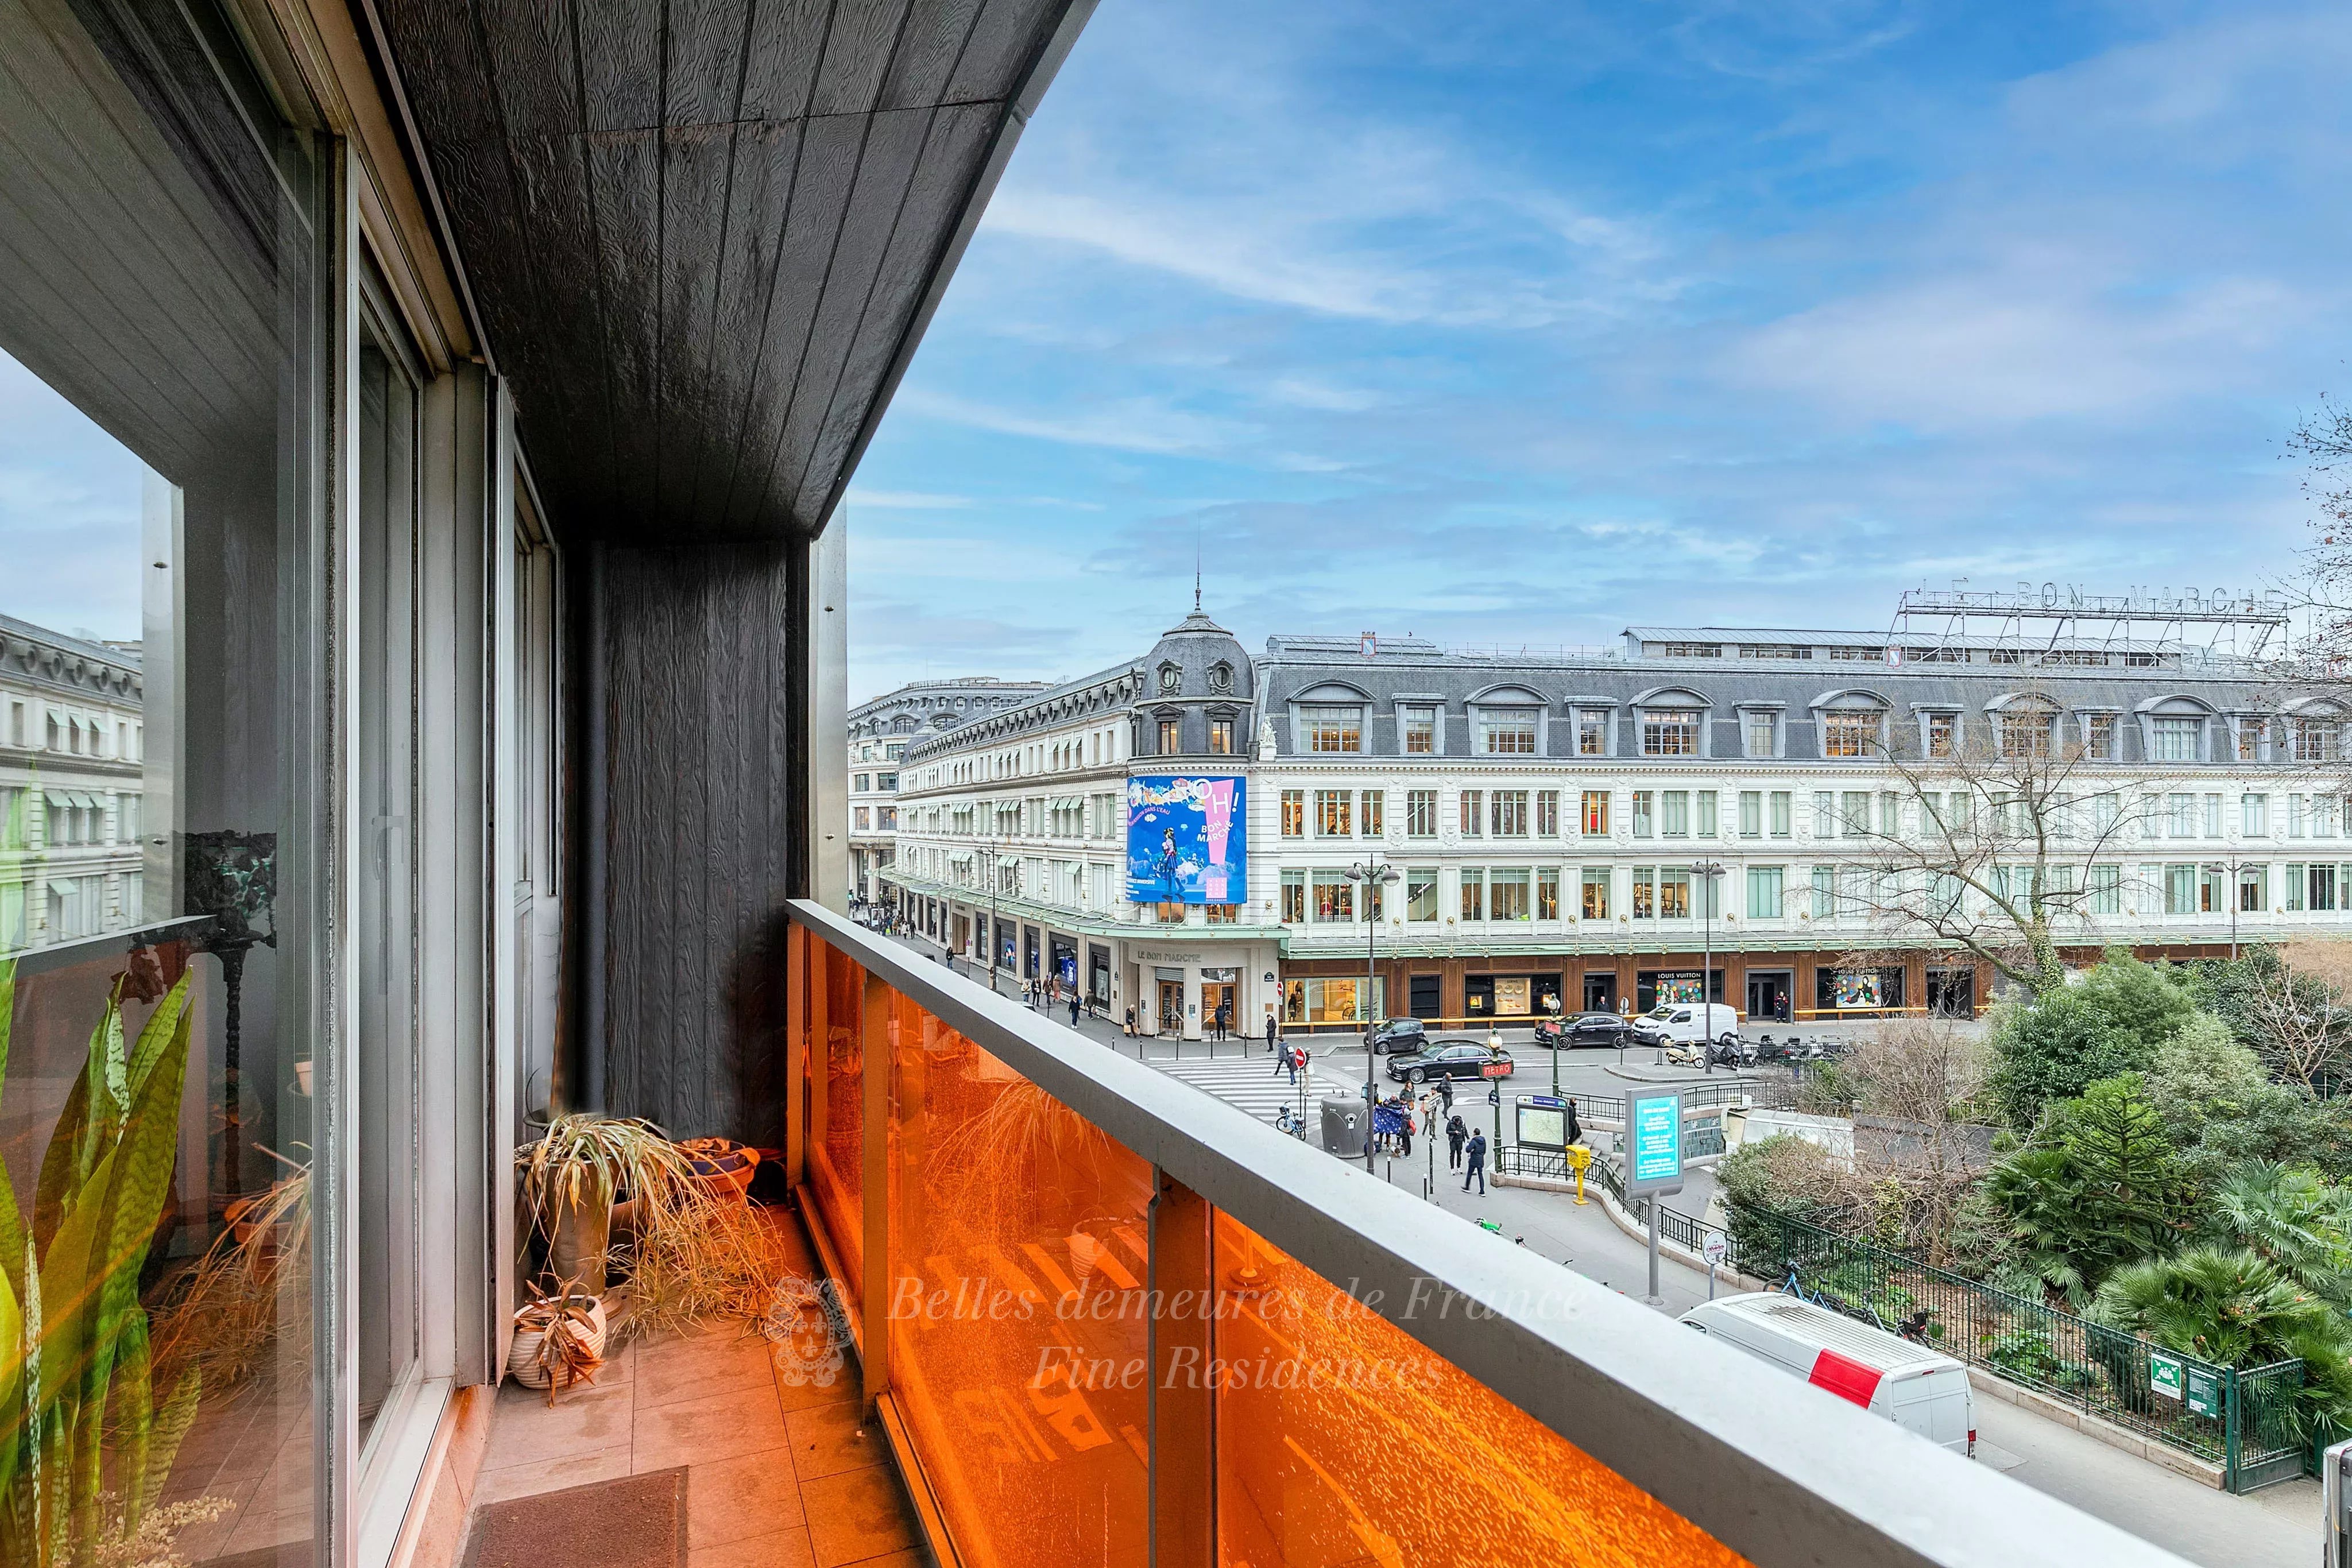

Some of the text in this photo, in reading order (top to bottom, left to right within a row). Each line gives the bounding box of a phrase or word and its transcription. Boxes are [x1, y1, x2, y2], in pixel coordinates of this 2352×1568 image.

[1923, 578, 1969, 605] LE
[2017, 581, 2084, 611] BON
[1193, 778, 1240, 814] OH!
[1156, 807, 1170, 815] L'EAU
[1201, 819, 1223, 834] BON
[1138, 951, 1145, 959] LE
[1147, 951, 1162, 961] BON
